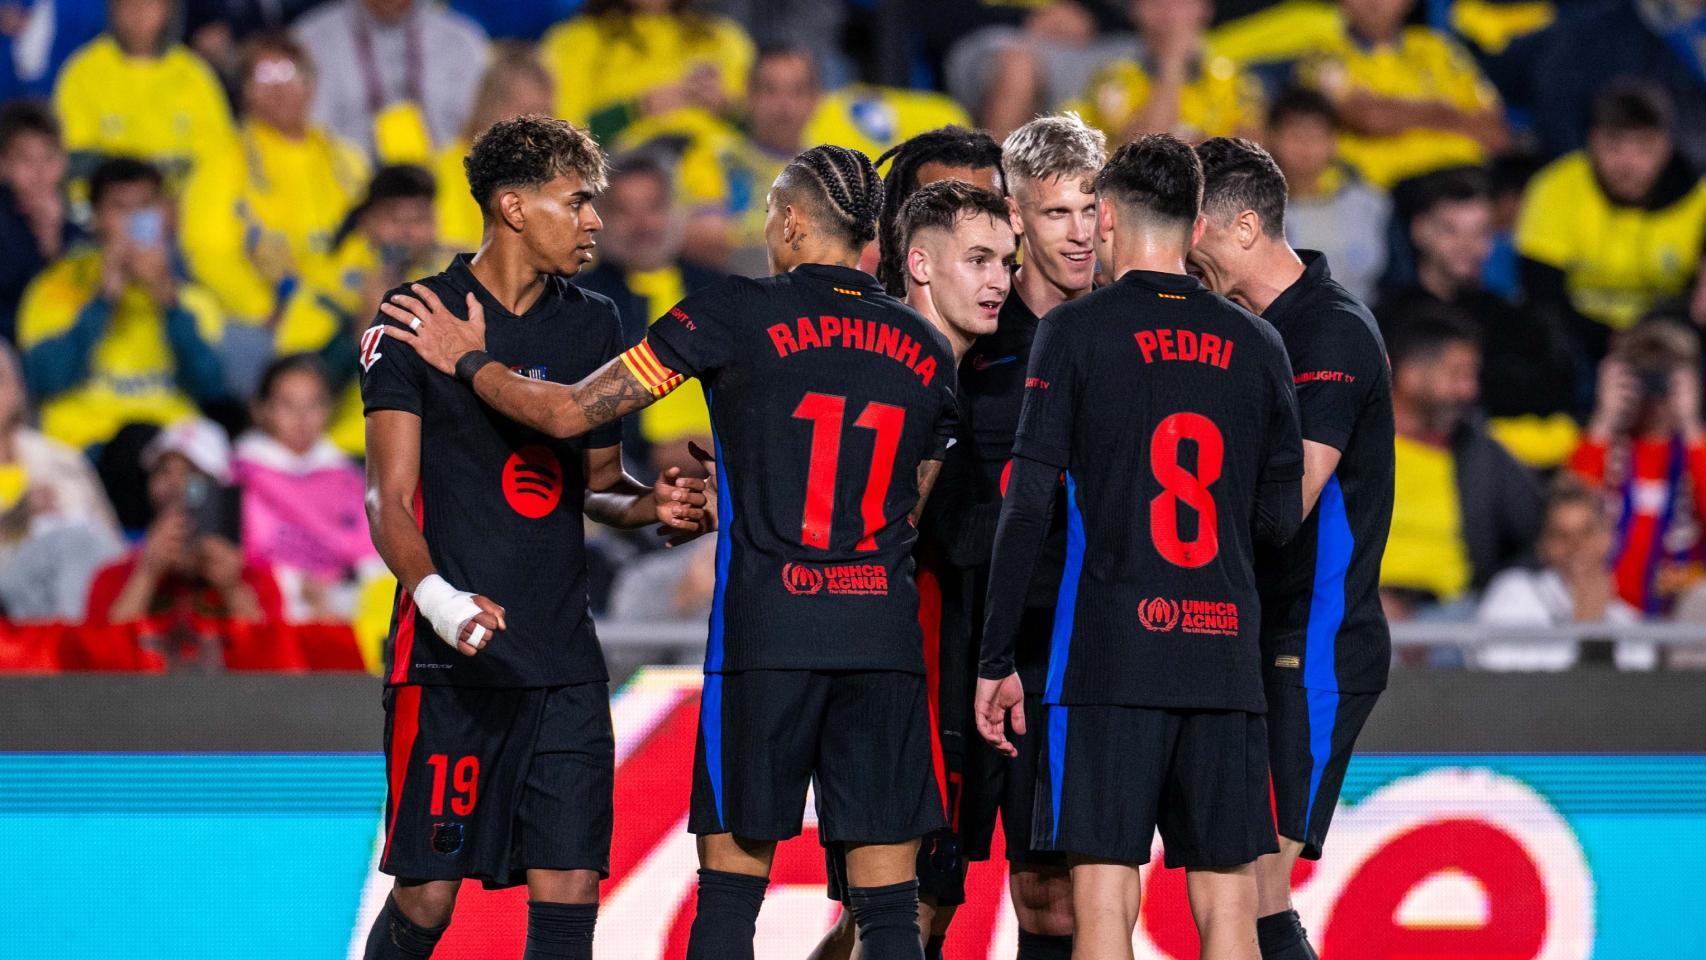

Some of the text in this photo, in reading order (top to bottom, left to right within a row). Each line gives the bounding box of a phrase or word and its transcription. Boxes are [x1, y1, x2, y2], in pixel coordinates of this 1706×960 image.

[767, 315, 938, 387] RAPHINHA
[1134, 328, 1234, 370] PEDRI
[1345, 374, 1356, 383] tv
[791, 391, 907, 551] 11
[1150, 411, 1225, 569] 8
[824, 565, 887, 578] UNHCR
[827, 577, 888, 589] ACNUR
[1182, 600, 1238, 616] UNHCR
[1182, 614, 1238, 629] ACNUR
[426, 753, 481, 817] 19
